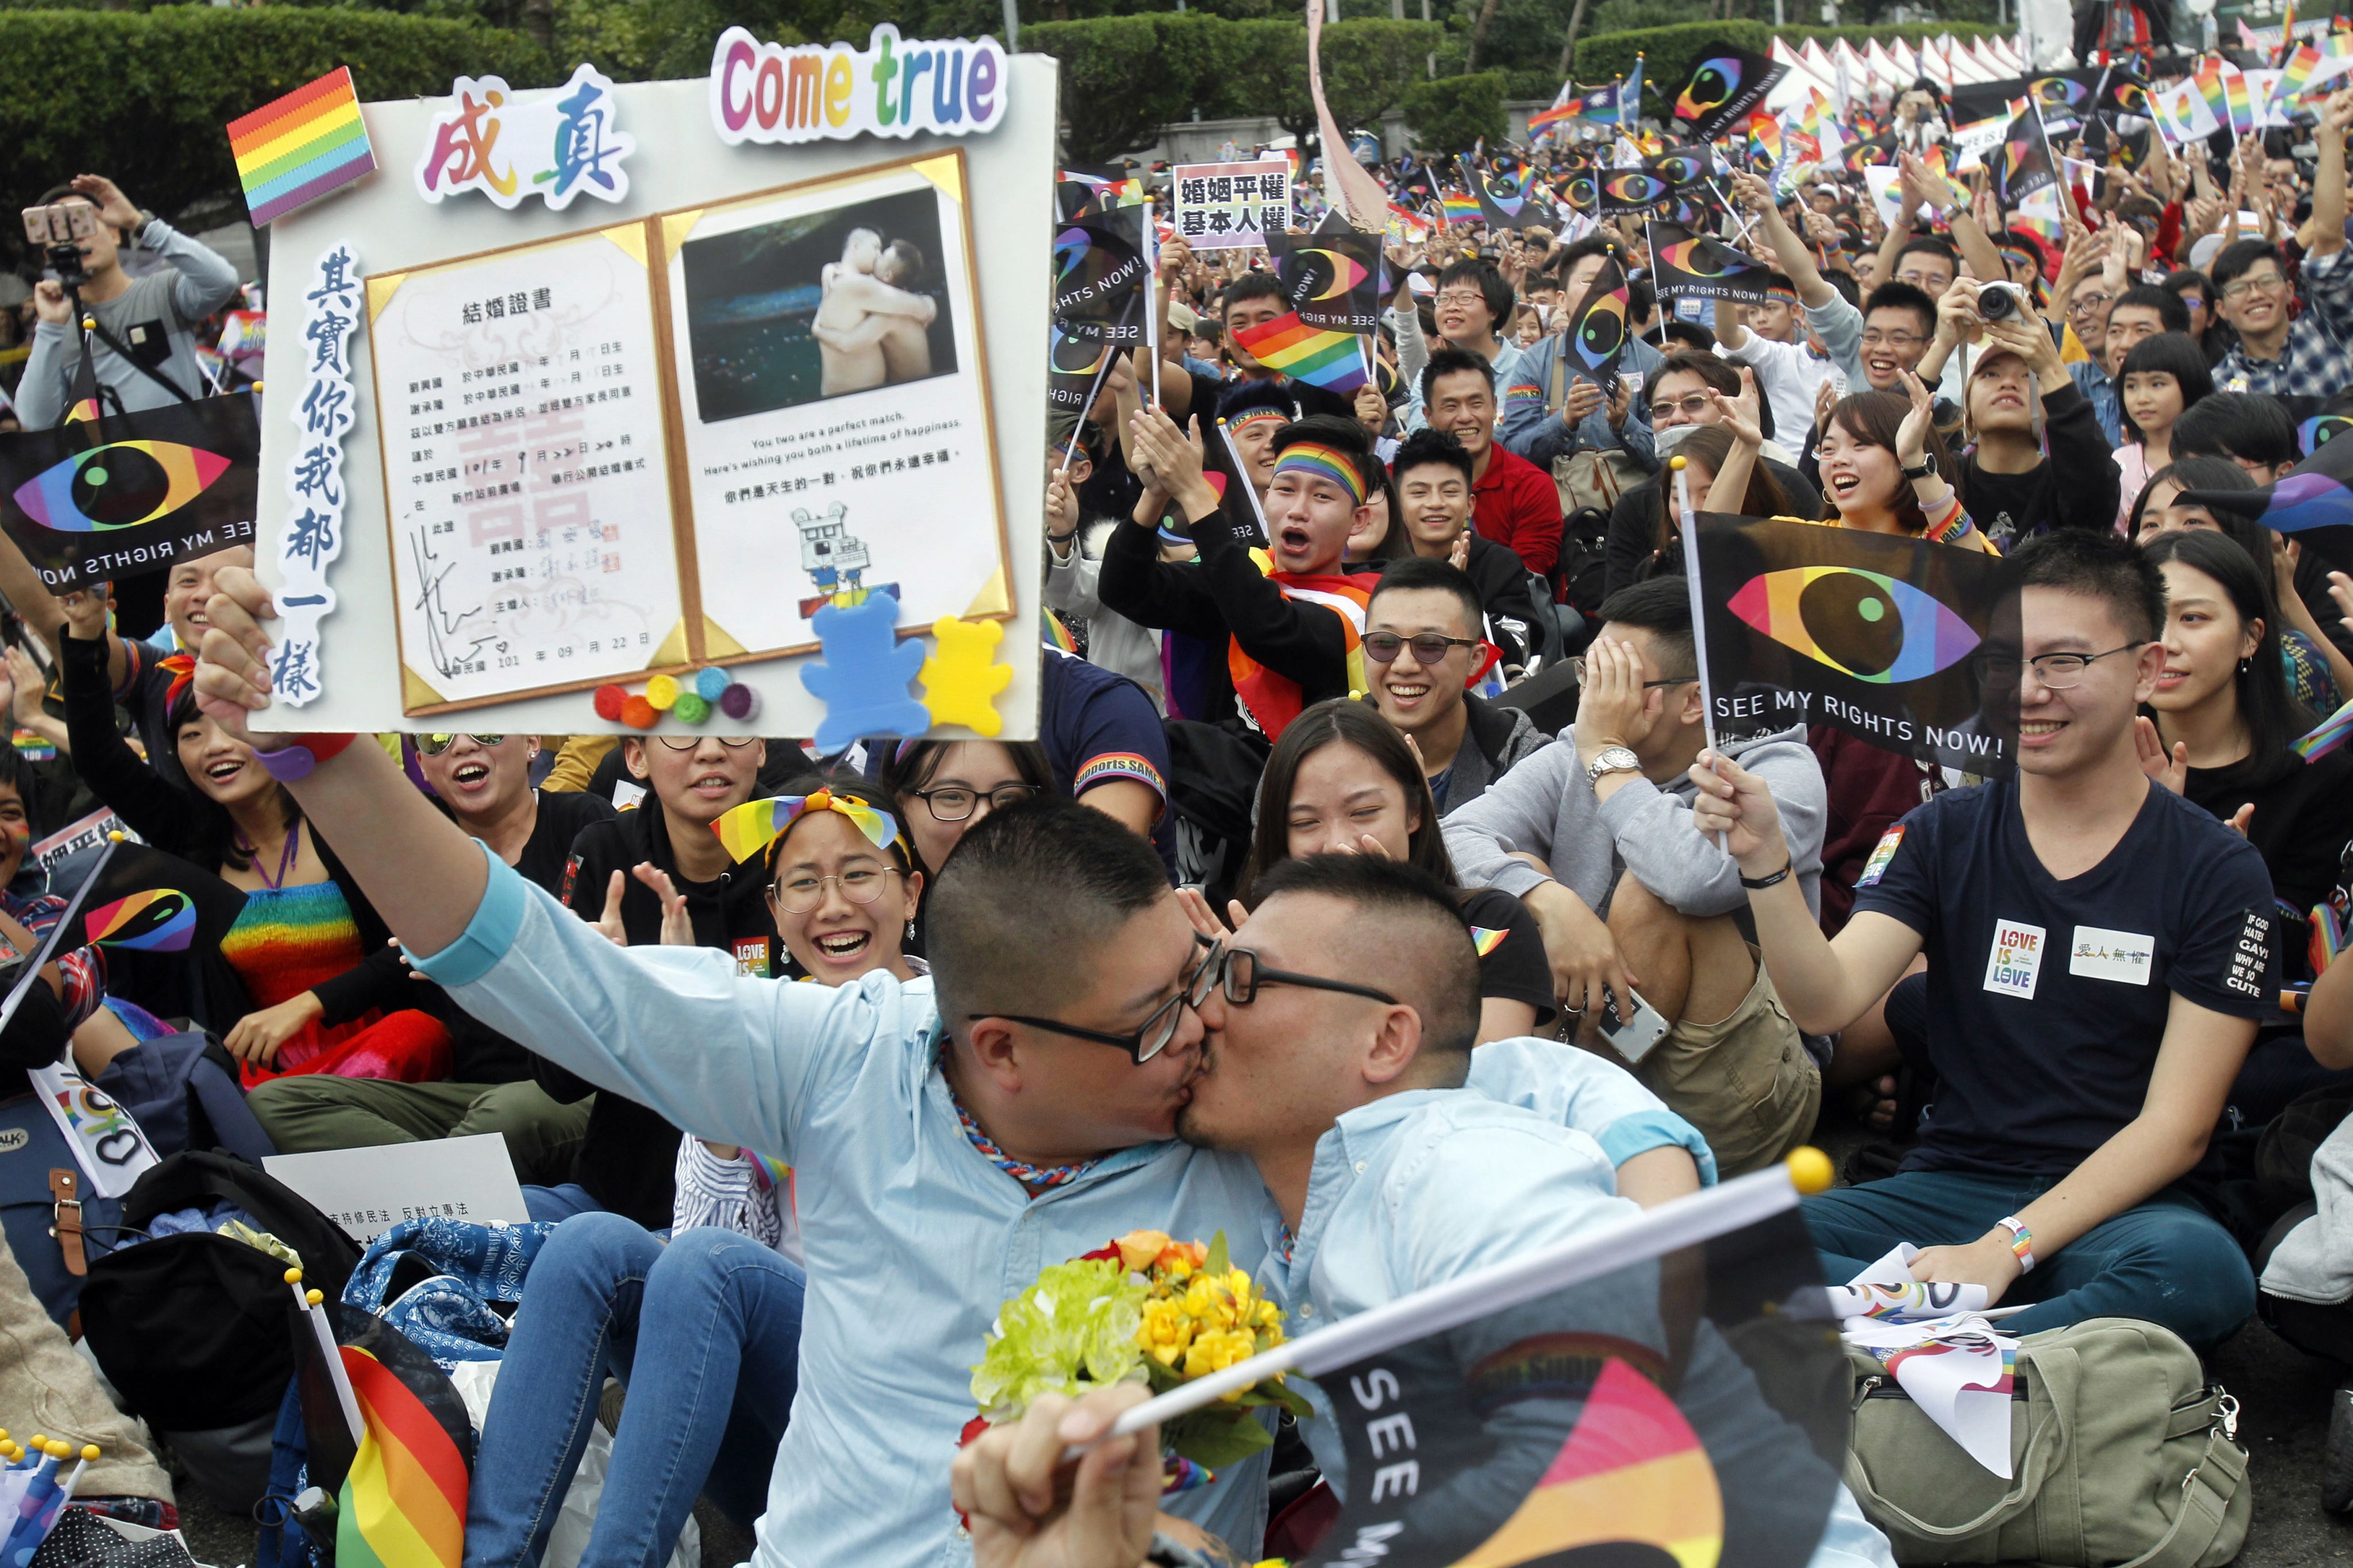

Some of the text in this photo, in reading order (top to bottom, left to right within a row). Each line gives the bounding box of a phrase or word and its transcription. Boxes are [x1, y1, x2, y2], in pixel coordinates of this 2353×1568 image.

[721, 34, 996, 130] Come true
[423, 82, 622, 196] 成真
[1181, 174, 1284, 204] 婚姻平權
[1182, 206, 1285, 235] 基本人權
[1097, 256, 1142, 292] NOW!
[1657, 287, 1669, 299] SEE
[1672, 285, 1685, 294] MY
[1689, 285, 1729, 296] RIGHTS
[1733, 290, 1763, 302] NOW!
[462, 287, 553, 325] 結婚證書
[462, 361, 519, 383] 於中華民國
[463, 383, 520, 404] 於中華民國
[751, 412, 905, 449] You two are a perfect match.
[704, 463, 737, 476] Here's
[741, 455, 781, 469] wishing
[785, 451, 804, 462] you
[808, 444, 831, 455] both
[844, 434, 886, 448] lifetime
[890, 430, 901, 439] of
[904, 419, 961, 437] happiness.
[272, 246, 355, 699] 其實你我都一樣
[412, 467, 457, 485] 中華民國
[492, 460, 502, 469] 年
[415, 500, 425, 511] 在
[498, 656, 519, 668] 101
[535, 650, 546, 661] 年
[558, 646, 572, 658] 09
[589, 640, 600, 652] 月
[612, 637, 626, 648] 22
[639, 632, 649, 644] 日
[1716, 691, 2003, 759] SEE MY RIGHTS NOW!
[2247, 914, 2269, 930] IF GOD
[2000, 929, 2038, 952] LOVE
[2243, 926, 2264, 942] HATES
[737, 944, 765, 960] LOVE
[1996, 947, 2012, 965] IS
[2078, 944, 2145, 964] 愛人無懼
[2239, 940, 2269, 959] GAYS
[738, 962, 749, 977] IS
[2232, 965, 2255, 982] WE SO
[2235, 953, 2266, 972] WHY ARE
[1993, 965, 2031, 988] LOVE
[2226, 977, 2261, 998] CUTE
[329, 1202, 469, 1226] 支持修民法 反對立專法
[1351, 1368, 1419, 1504] SEE
